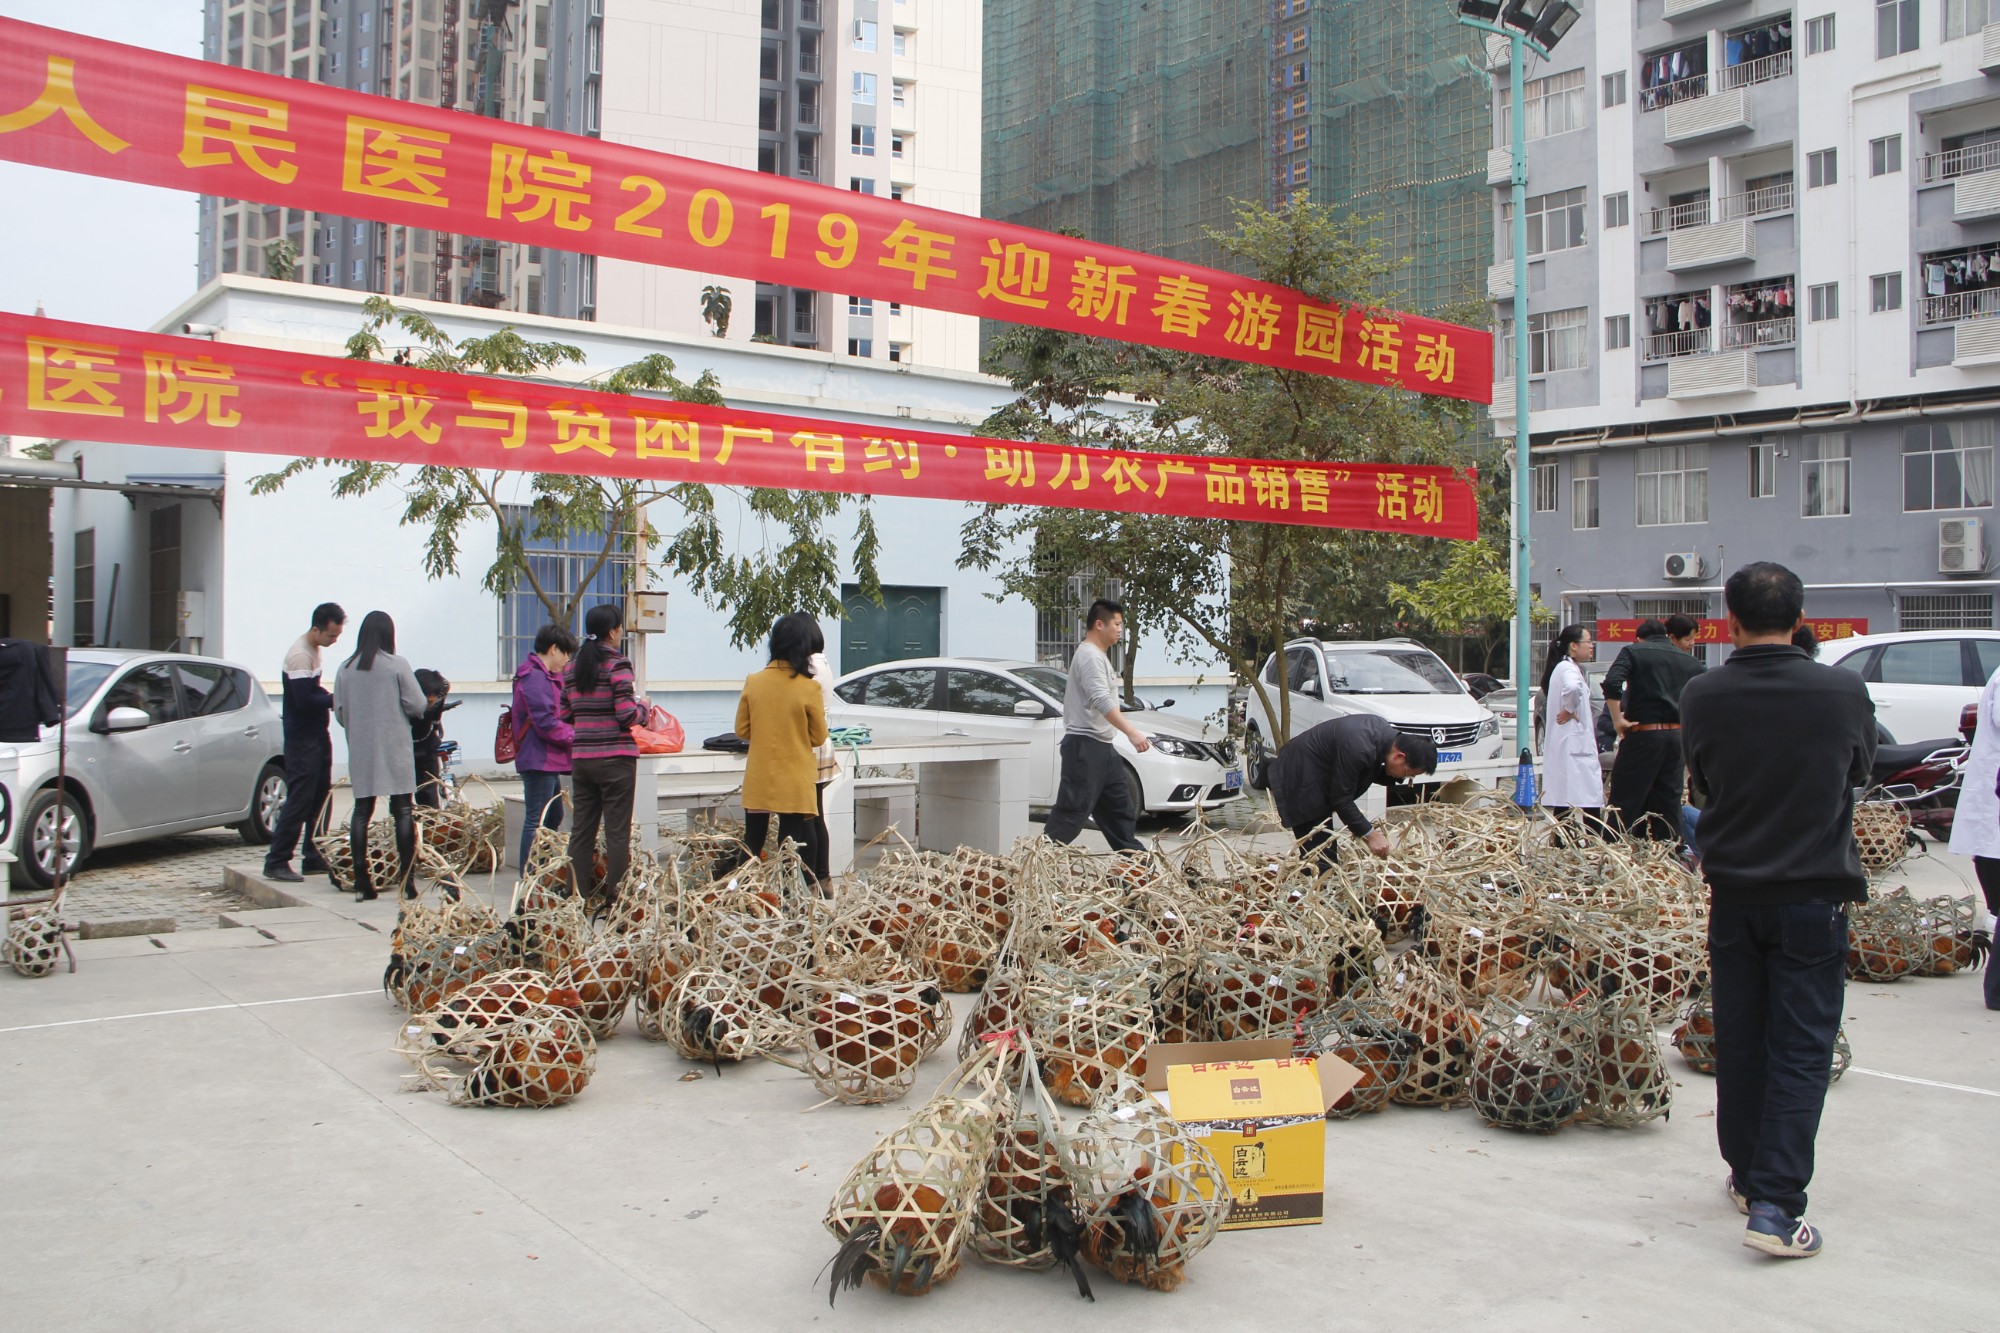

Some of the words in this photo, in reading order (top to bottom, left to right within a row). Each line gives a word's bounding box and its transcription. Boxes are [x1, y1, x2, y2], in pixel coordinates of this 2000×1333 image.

[0, 55, 1456, 384] 人民医院2019年迎新春游园活动
[0, 335, 1443, 524] 医院“我与贫困户有约·助力农产品销售”活动
[1235, 1147, 1248, 1176] 白云边
[1243, 1187, 1251, 1200] 4
